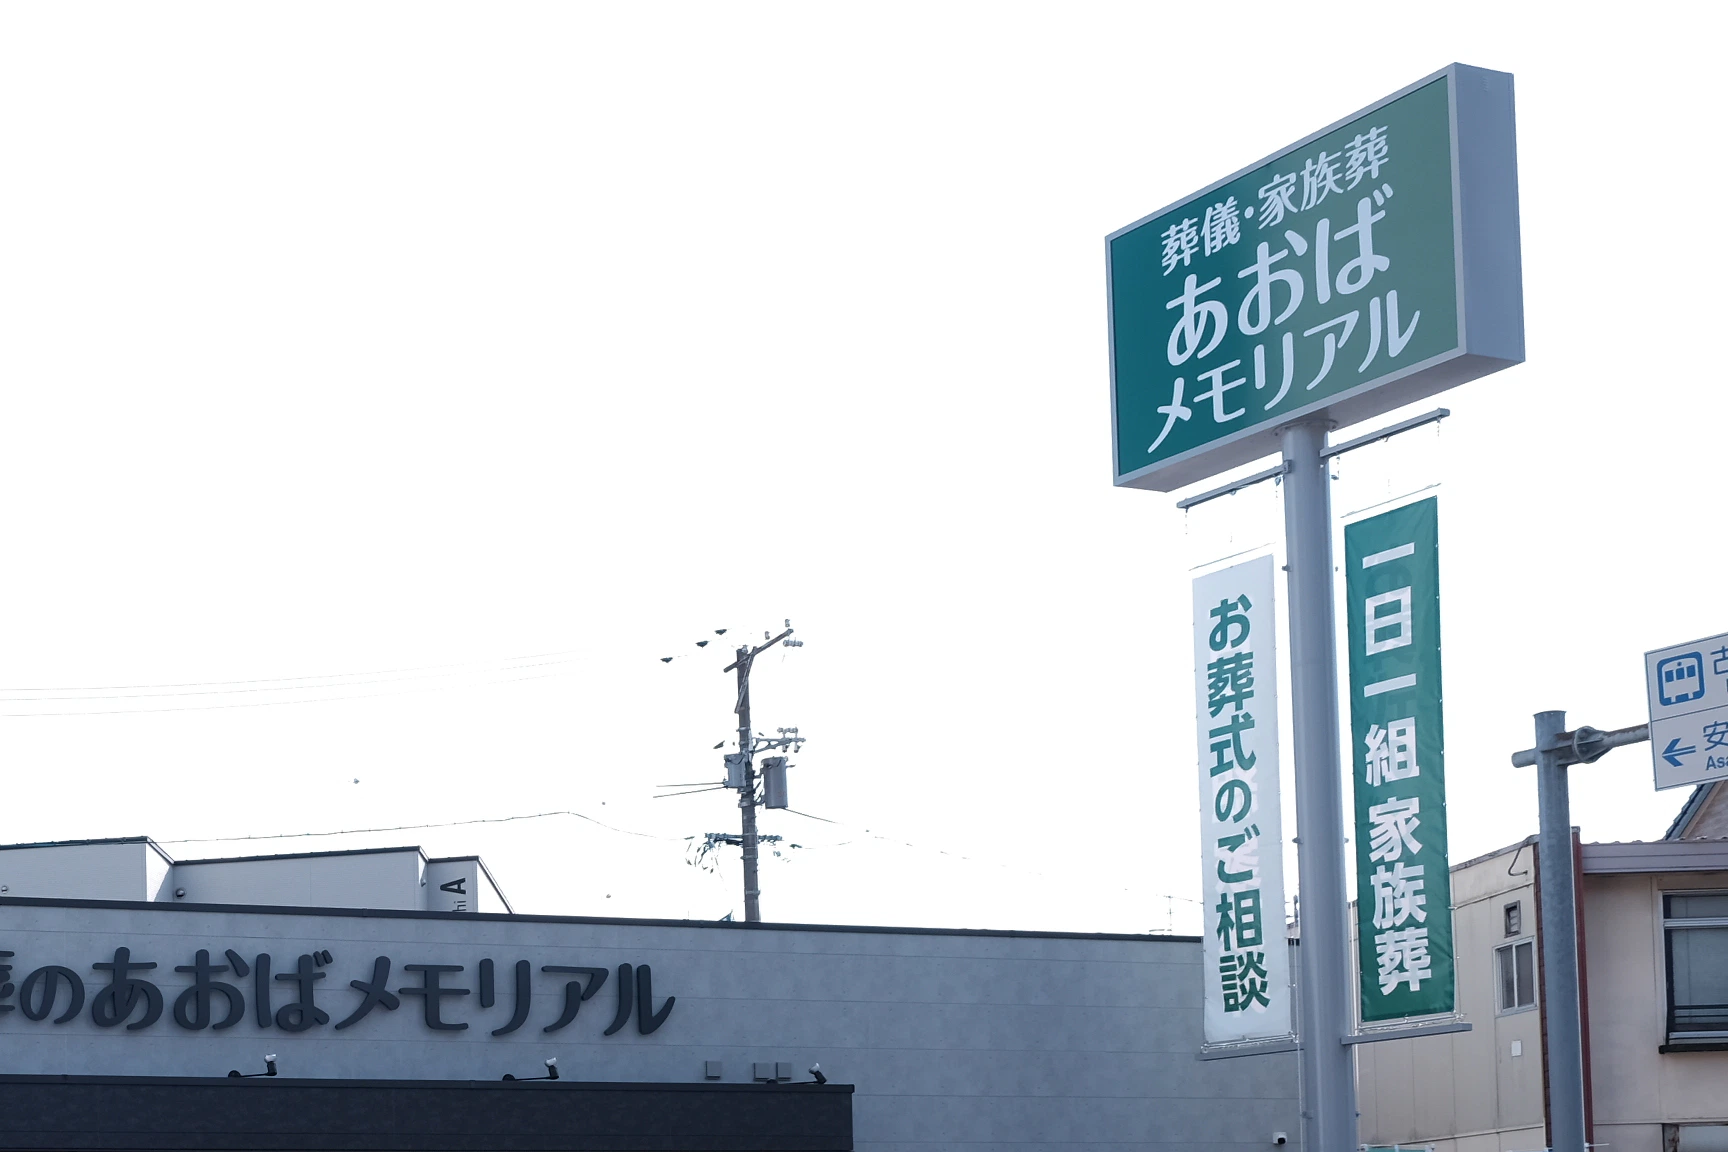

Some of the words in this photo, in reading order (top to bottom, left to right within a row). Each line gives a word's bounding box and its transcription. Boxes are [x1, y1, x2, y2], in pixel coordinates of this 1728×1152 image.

[1160, 126, 1389, 276] 葬儀・家族葬
[1164, 186, 1394, 366] あおば
[1147, 289, 1420, 453] メモリアル
[1206, 594, 1270, 1014] お葬式のご相談
[1362, 542, 1432, 996] 一日一組家族葬
[1703, 720, 1728, 751] 安
